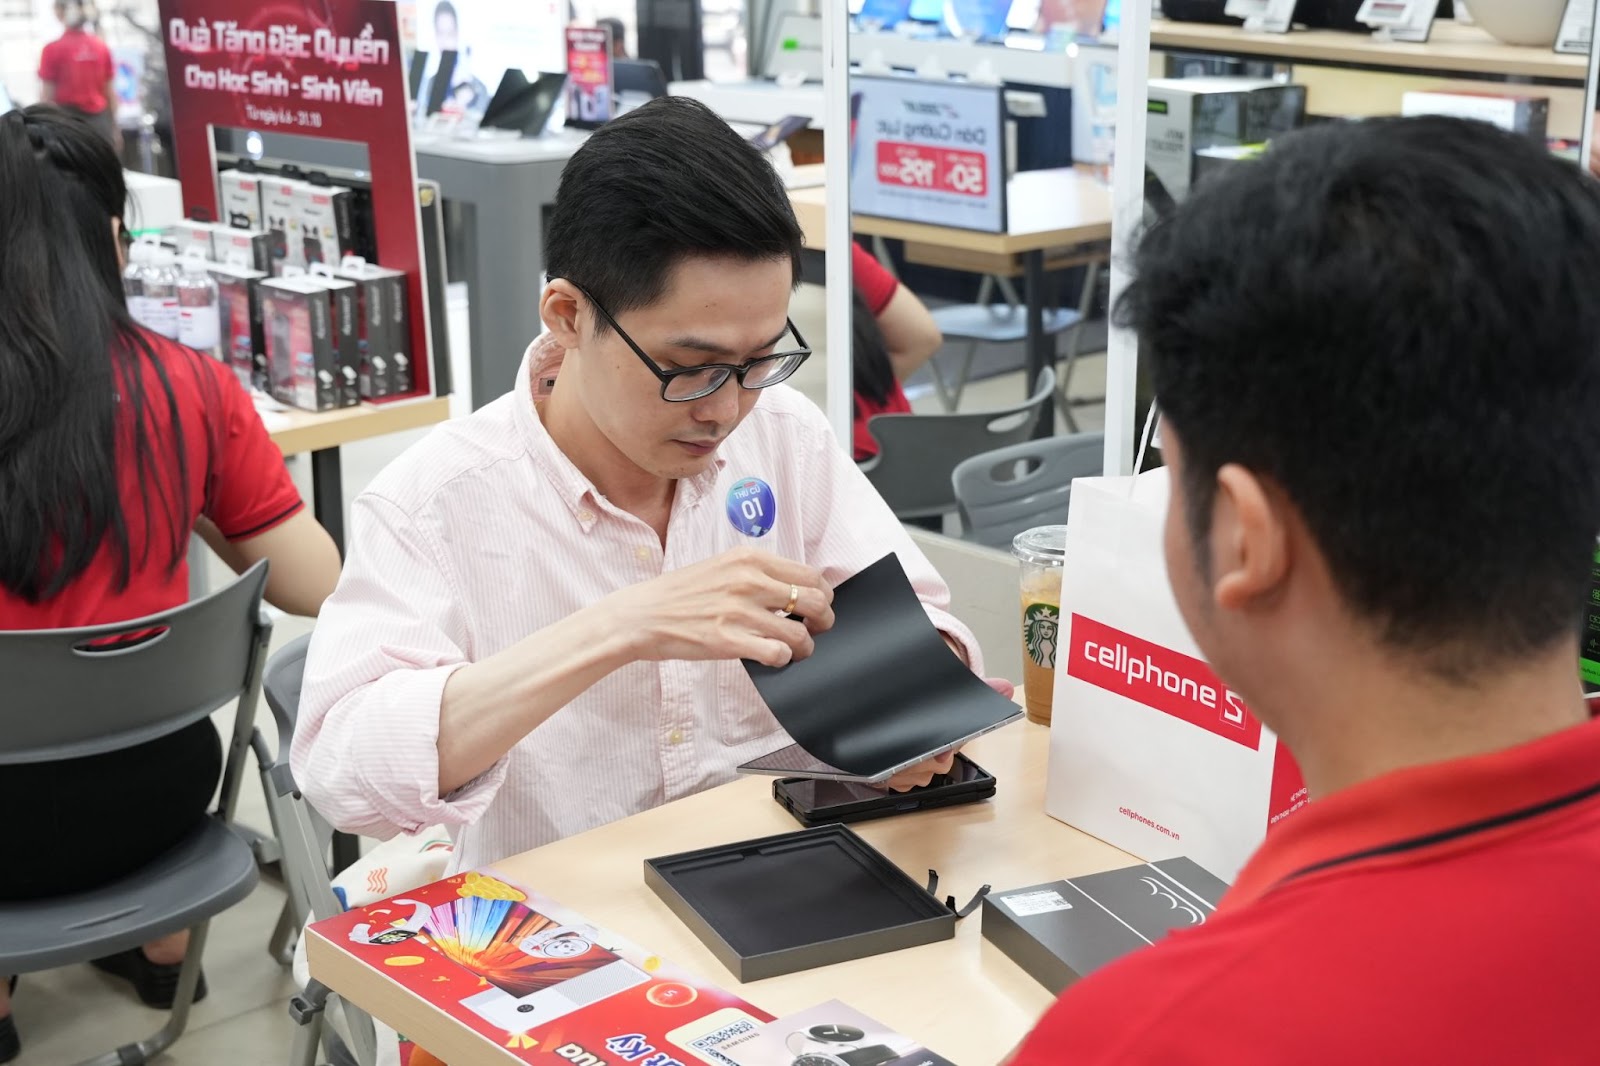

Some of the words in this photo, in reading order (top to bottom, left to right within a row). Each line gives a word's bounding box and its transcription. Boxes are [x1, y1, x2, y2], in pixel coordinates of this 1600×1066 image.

[169, 17, 211, 50] Quà
[213, 21, 266, 55] Tăng
[314, 23, 389, 64] Quyền
[184, 64, 216, 90] Cho
[250, 70, 289, 97] Sinh
[301, 75, 341, 102] Sinh
[343, 79, 383, 106] Viên
[734, 489, 749, 499] THU
[741, 497, 763, 519] 01
[1084, 640, 1217, 709] cellphone
[1118, 806, 1180, 841] cellphones.com.vn
[720, 1032, 761, 1052] SAMSUNG
